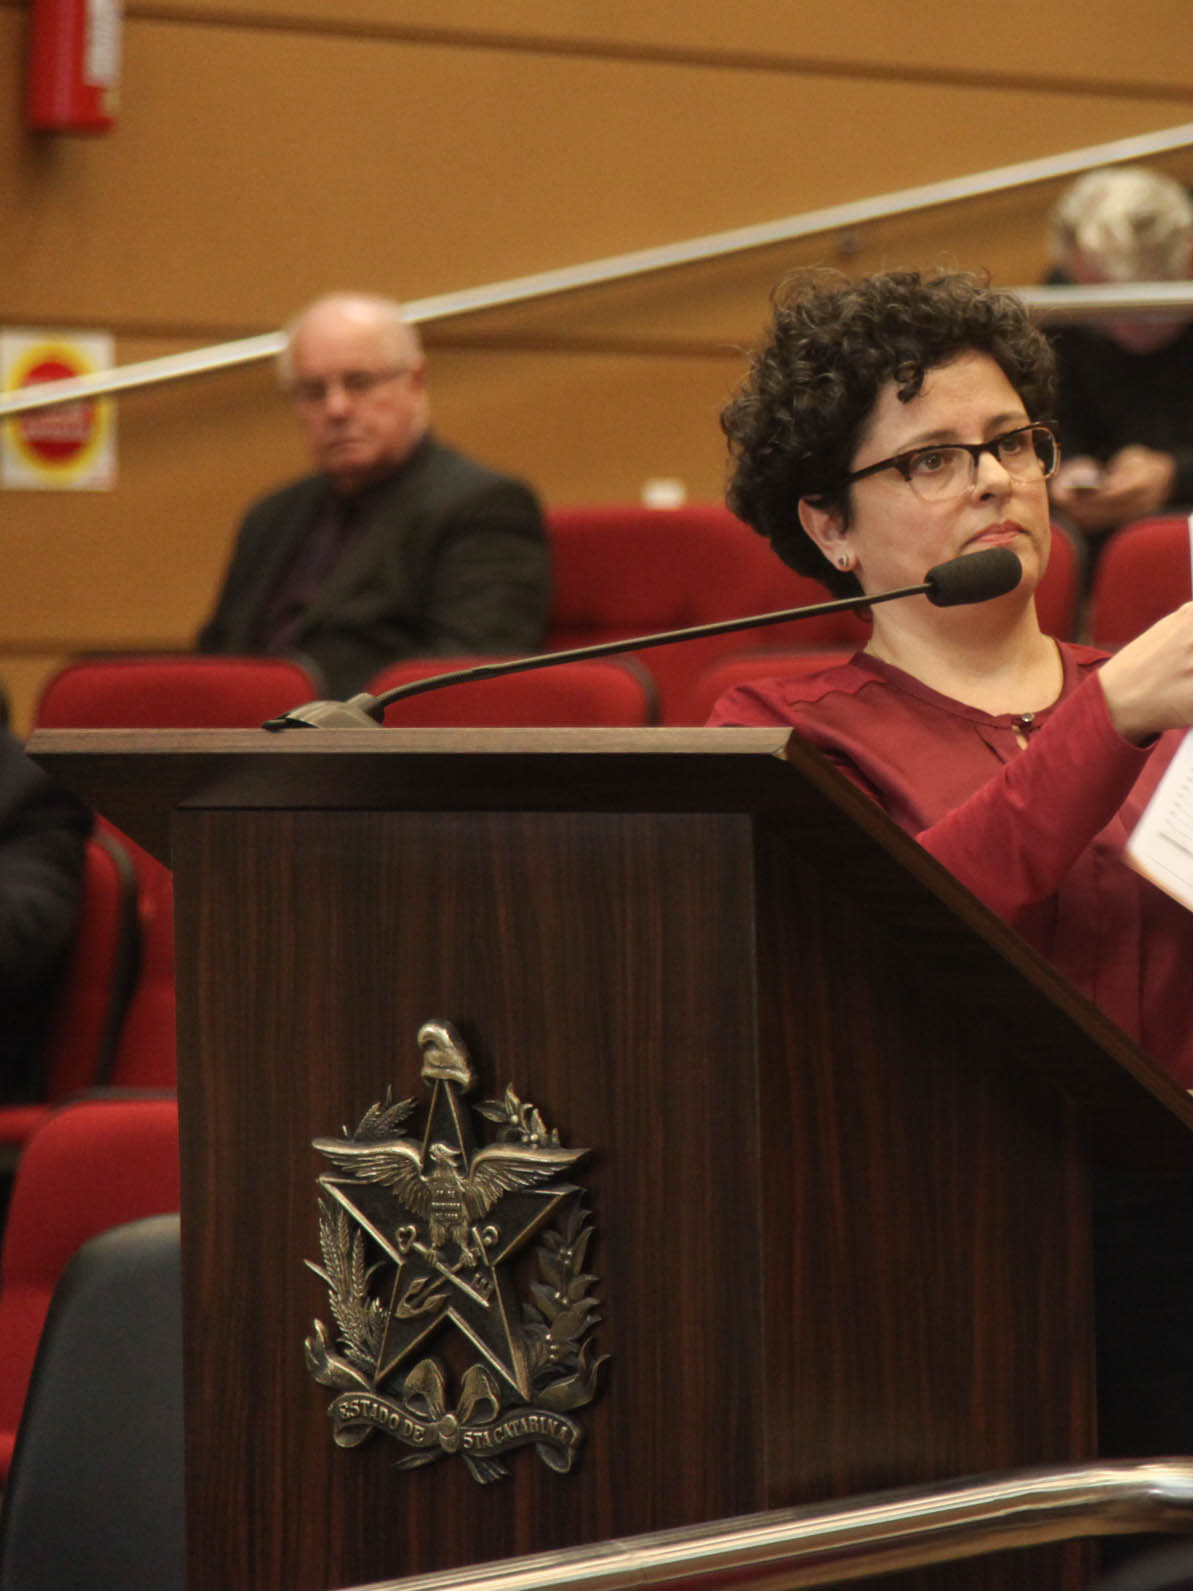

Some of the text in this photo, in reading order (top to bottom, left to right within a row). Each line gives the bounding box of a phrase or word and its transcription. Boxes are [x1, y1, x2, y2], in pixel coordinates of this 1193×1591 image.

[338, 1400, 569, 1449] ESTADO DE STA CATARINA
